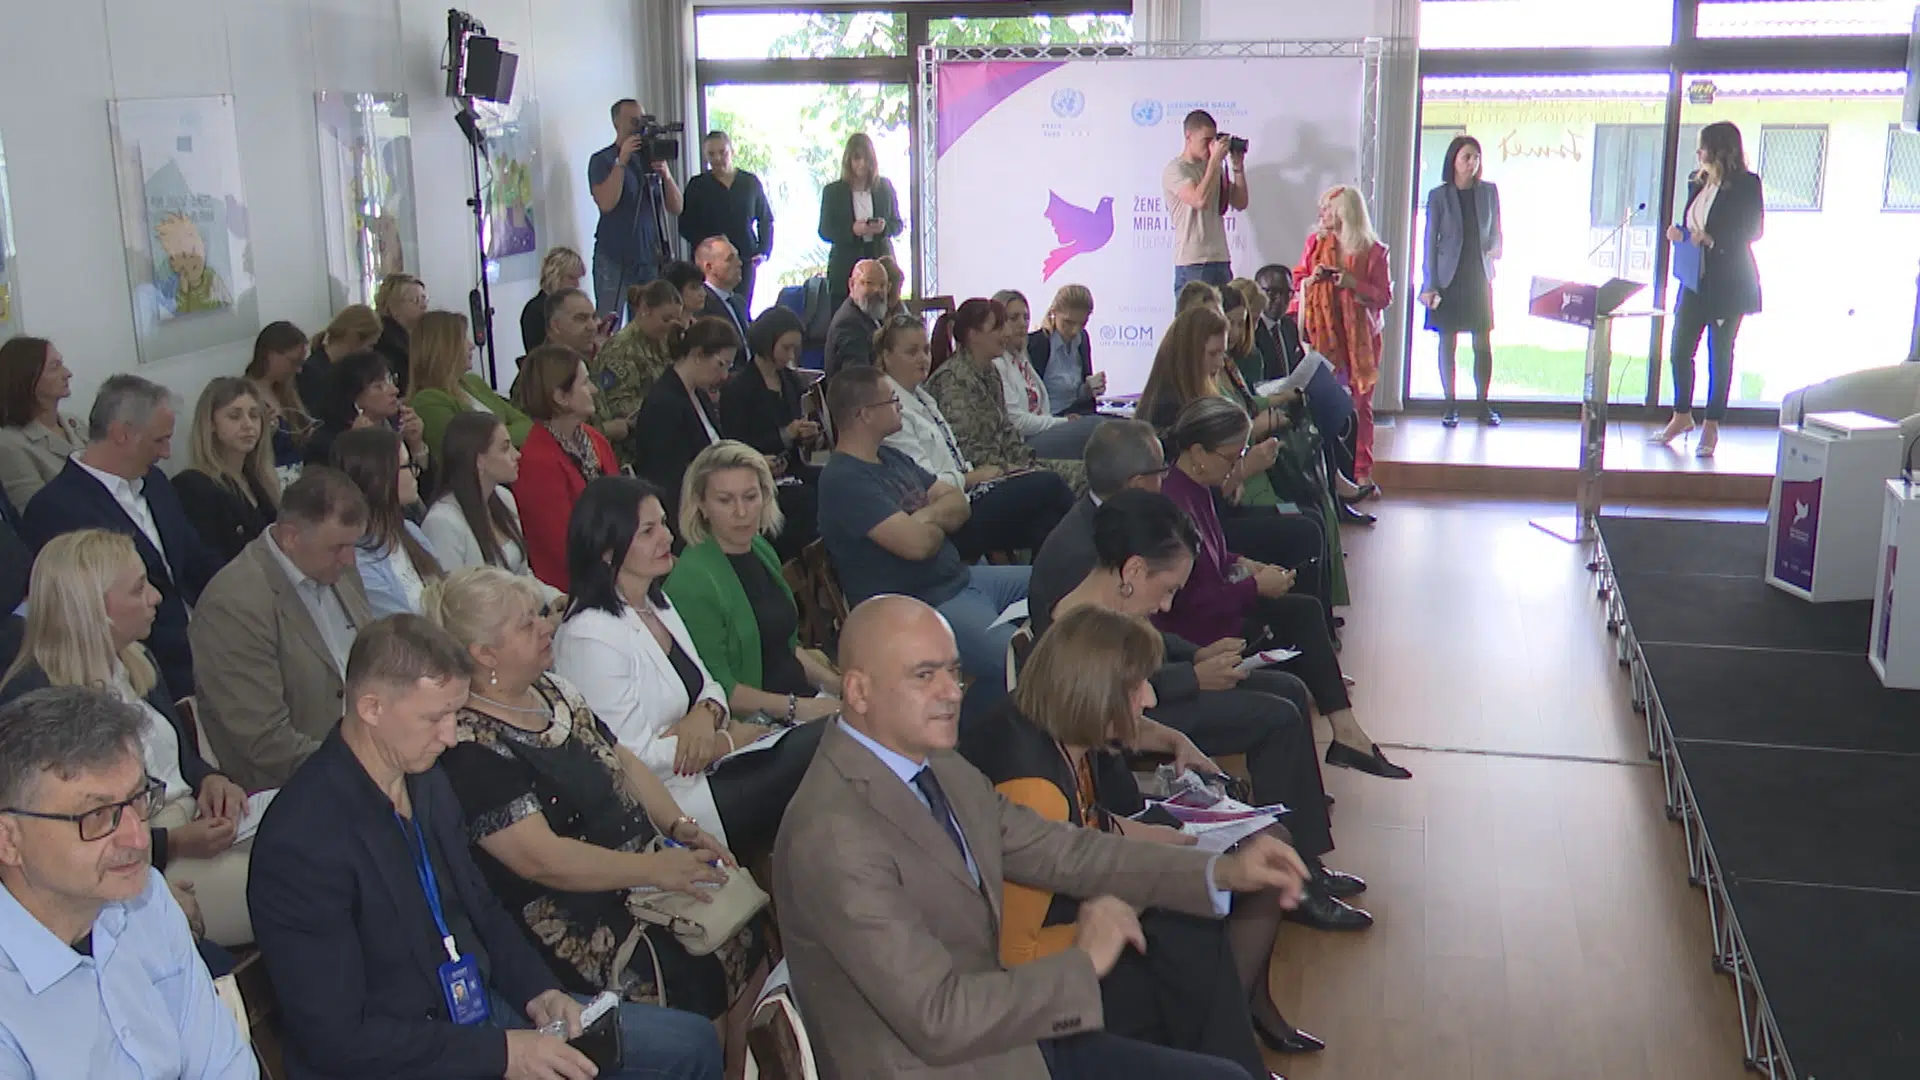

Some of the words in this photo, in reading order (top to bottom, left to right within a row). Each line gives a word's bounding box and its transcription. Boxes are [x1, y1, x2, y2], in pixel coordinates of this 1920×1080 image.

[1133, 195, 1161, 212] ŽENE
[1133, 217, 1161, 231] MIRA
[1119, 324, 1153, 341] IOM
